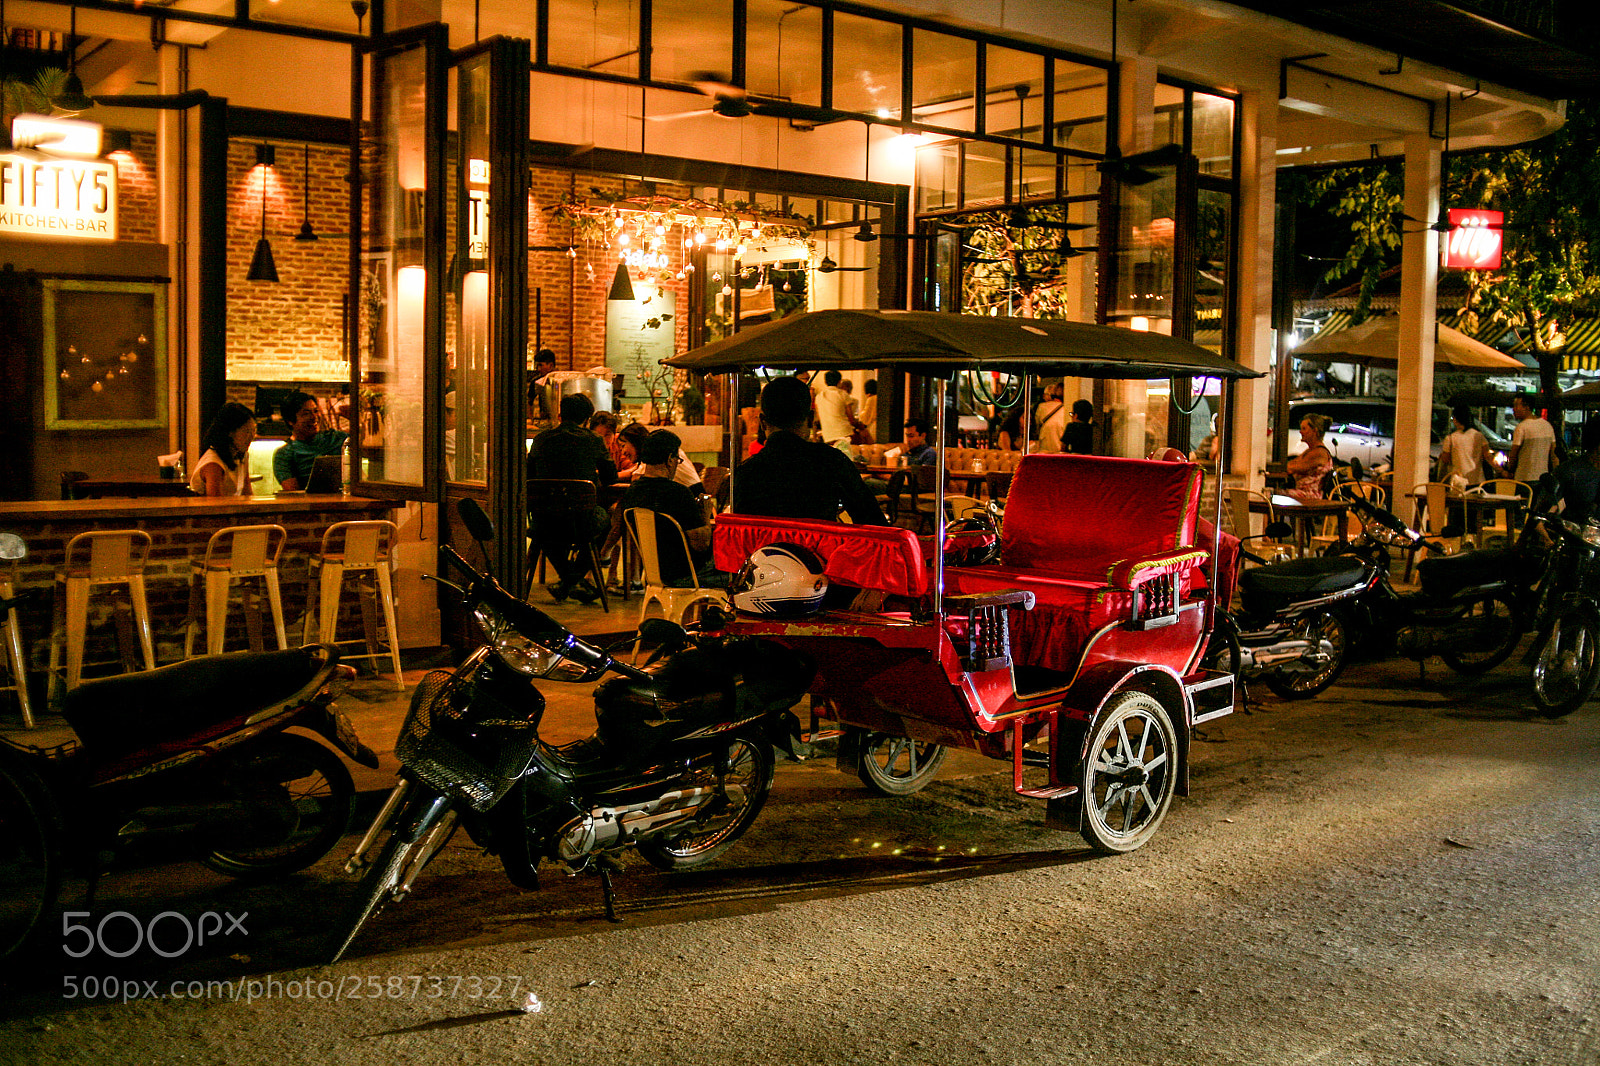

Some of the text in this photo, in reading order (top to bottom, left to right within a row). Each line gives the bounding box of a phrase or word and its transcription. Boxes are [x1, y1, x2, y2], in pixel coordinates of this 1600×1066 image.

[0, 161, 108, 214] FIFTY5
[0, 211, 108, 233] KITCHEN-BAR
[1450, 216, 1501, 264] illy
